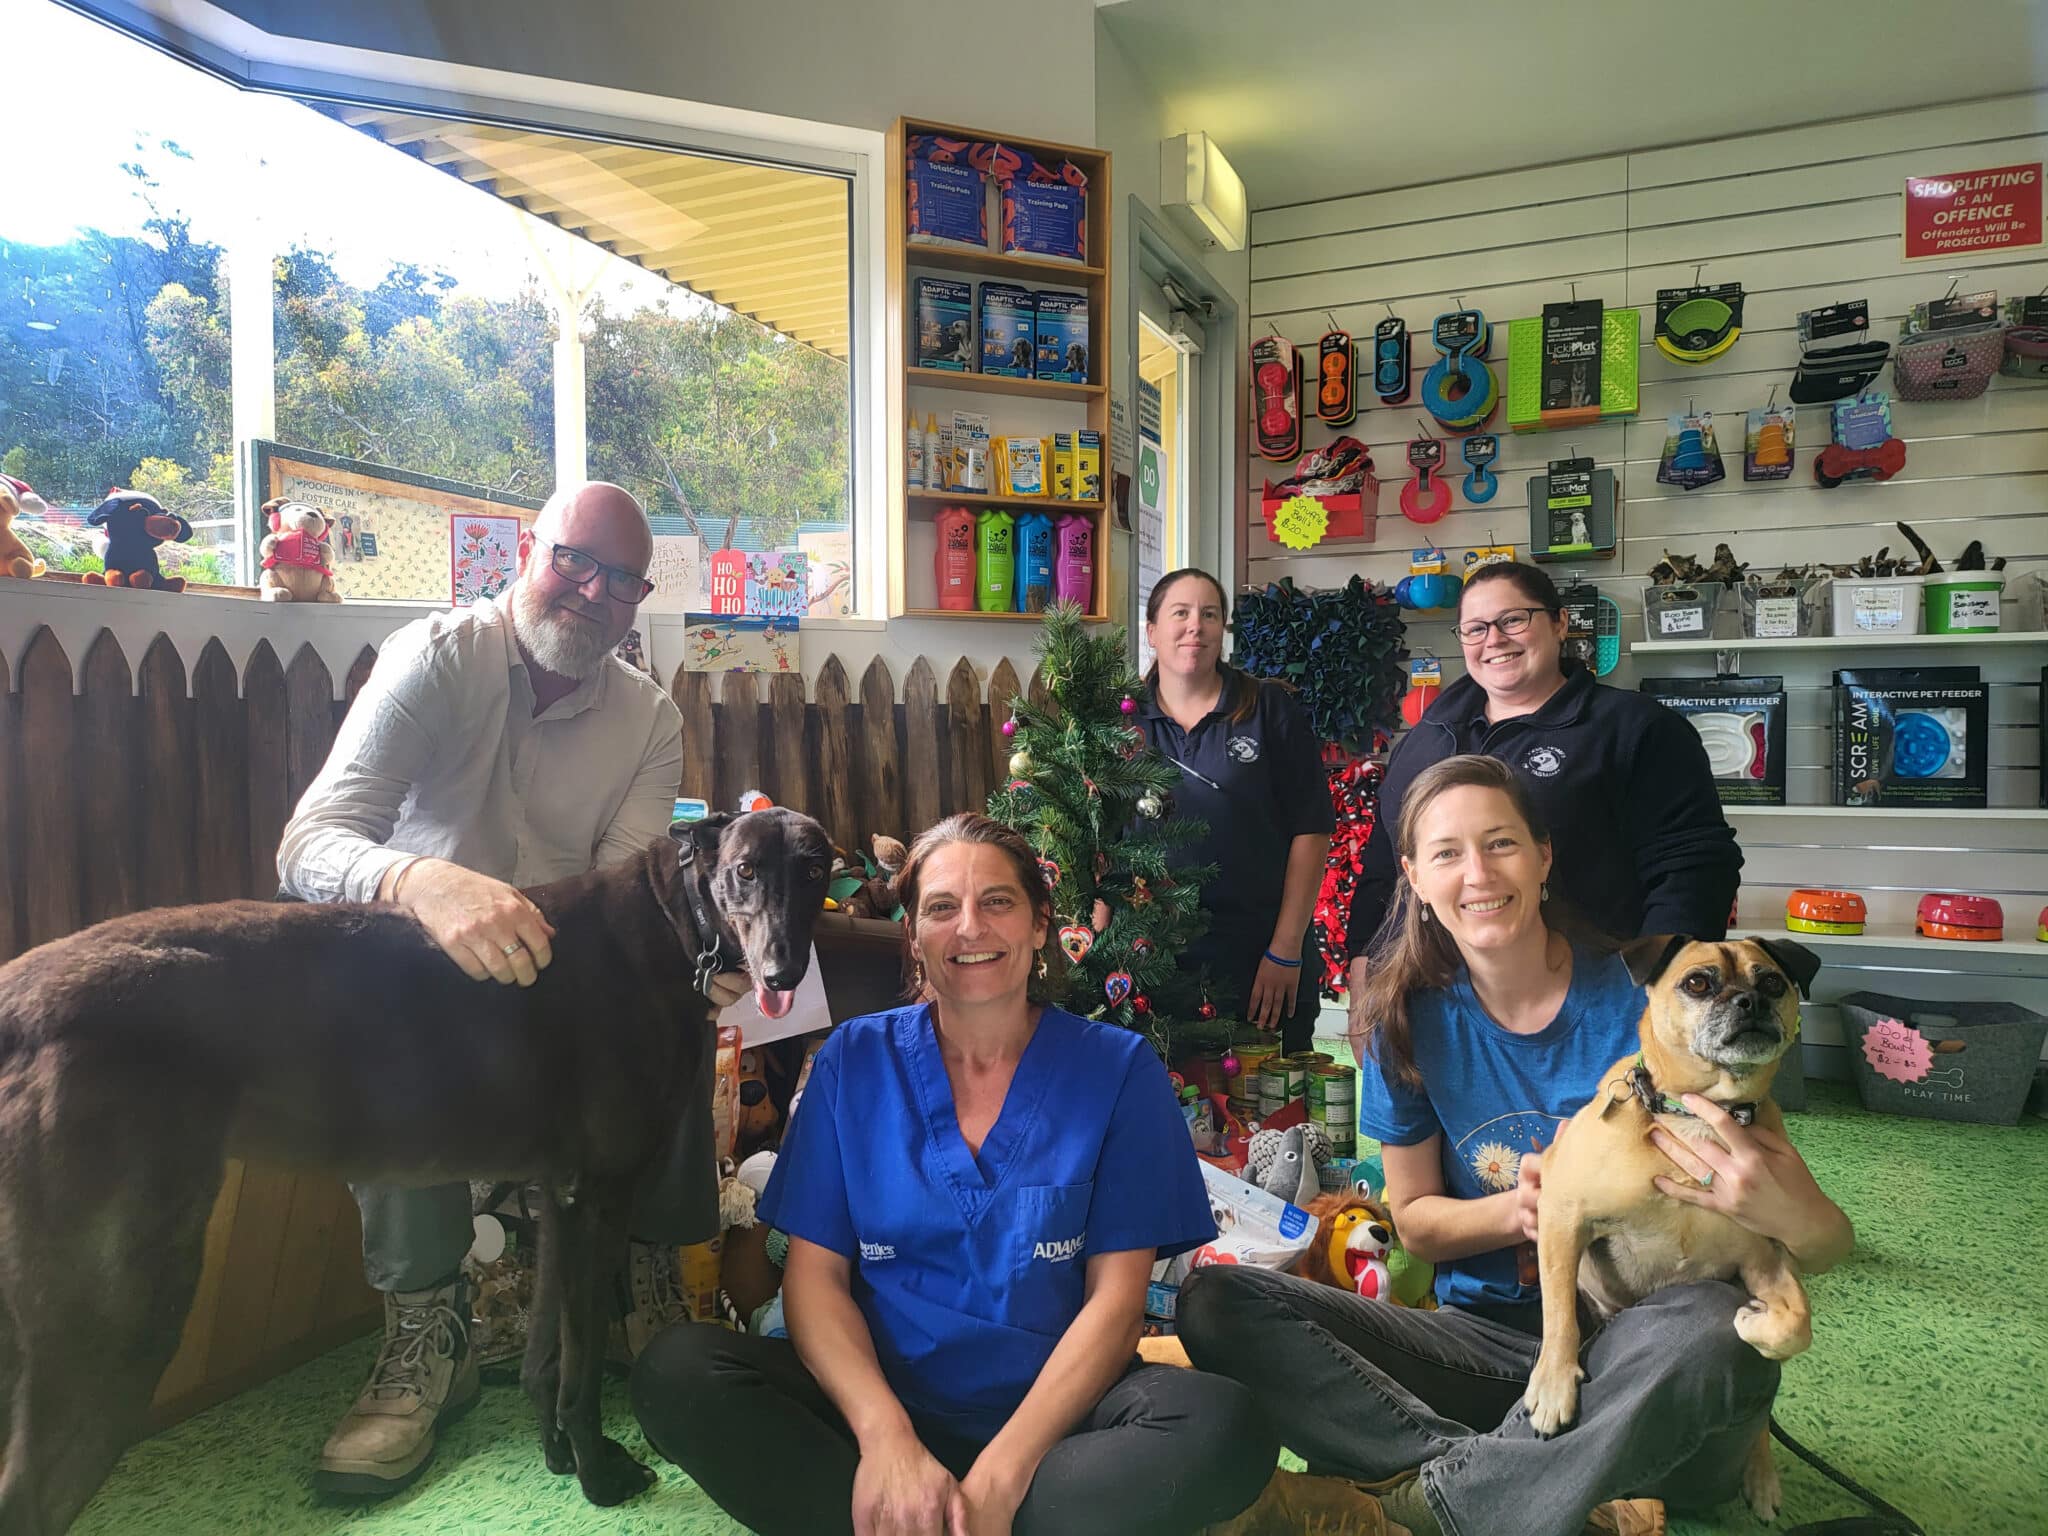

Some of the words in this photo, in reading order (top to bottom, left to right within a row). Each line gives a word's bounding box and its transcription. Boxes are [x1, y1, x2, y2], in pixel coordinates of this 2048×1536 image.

[928, 163, 969, 177] TotalCare
[930, 181, 955, 194] Training
[956, 187, 971, 198] Pads
[1027, 181, 1068, 192] TotalCare
[1914, 171, 2036, 198] SHOPLIFTING
[1027, 199, 1053, 209] Training
[1053, 203, 1069, 211] Pads
[1954, 196, 1966, 206] IS
[1972, 193, 1992, 205] AN
[1934, 204, 2015, 225] OFFENCE
[1922, 226, 1982, 241] Offenders
[1985, 222, 2007, 233] Will
[2011, 221, 2026, 231] Be
[1937, 233, 2011, 250] PROSECUTED
[922, 285, 950, 296] ADAPTIL
[986, 295, 1014, 305] ADAPTIL
[1039, 301, 1068, 310] ADAPTIL
[1071, 303, 1089, 311] Calm
[954, 422, 985, 433] sunstick
[1143, 465, 1156, 488] DO
[302, 480, 343, 495] POOCHES
[345, 487, 355, 496] IN
[301, 494, 334, 507] FOSTER
[335, 498, 357, 510] CARE
[717, 562, 732, 575] HO
[714, 577, 737, 596] HO
[721, 598, 741, 614] HO
[1658, 698, 1717, 707] TERACTIVE
[1718, 698, 1738, 706] PET
[1739, 698, 1780, 706] FEEDER
[1852, 690, 1919, 700] INTERACTIVE
[1920, 690, 1940, 699] PET
[1941, 690, 1982, 699] FEEDER
[1872, 706, 1880, 728] LOUD
[1850, 702, 1869, 778] SCREAM
[1872, 735, 1880, 751] LIFE
[1872, 758, 1880, 775] LIVE
[1876, 1024, 1914, 1050] Dog
[1880, 1037, 1915, 1055] Bowls
[1904, 1087, 1935, 1099] PLAY
[1943, 1091, 1972, 1103] TIME
[1033, 1231, 1086, 1259] ADVANC
